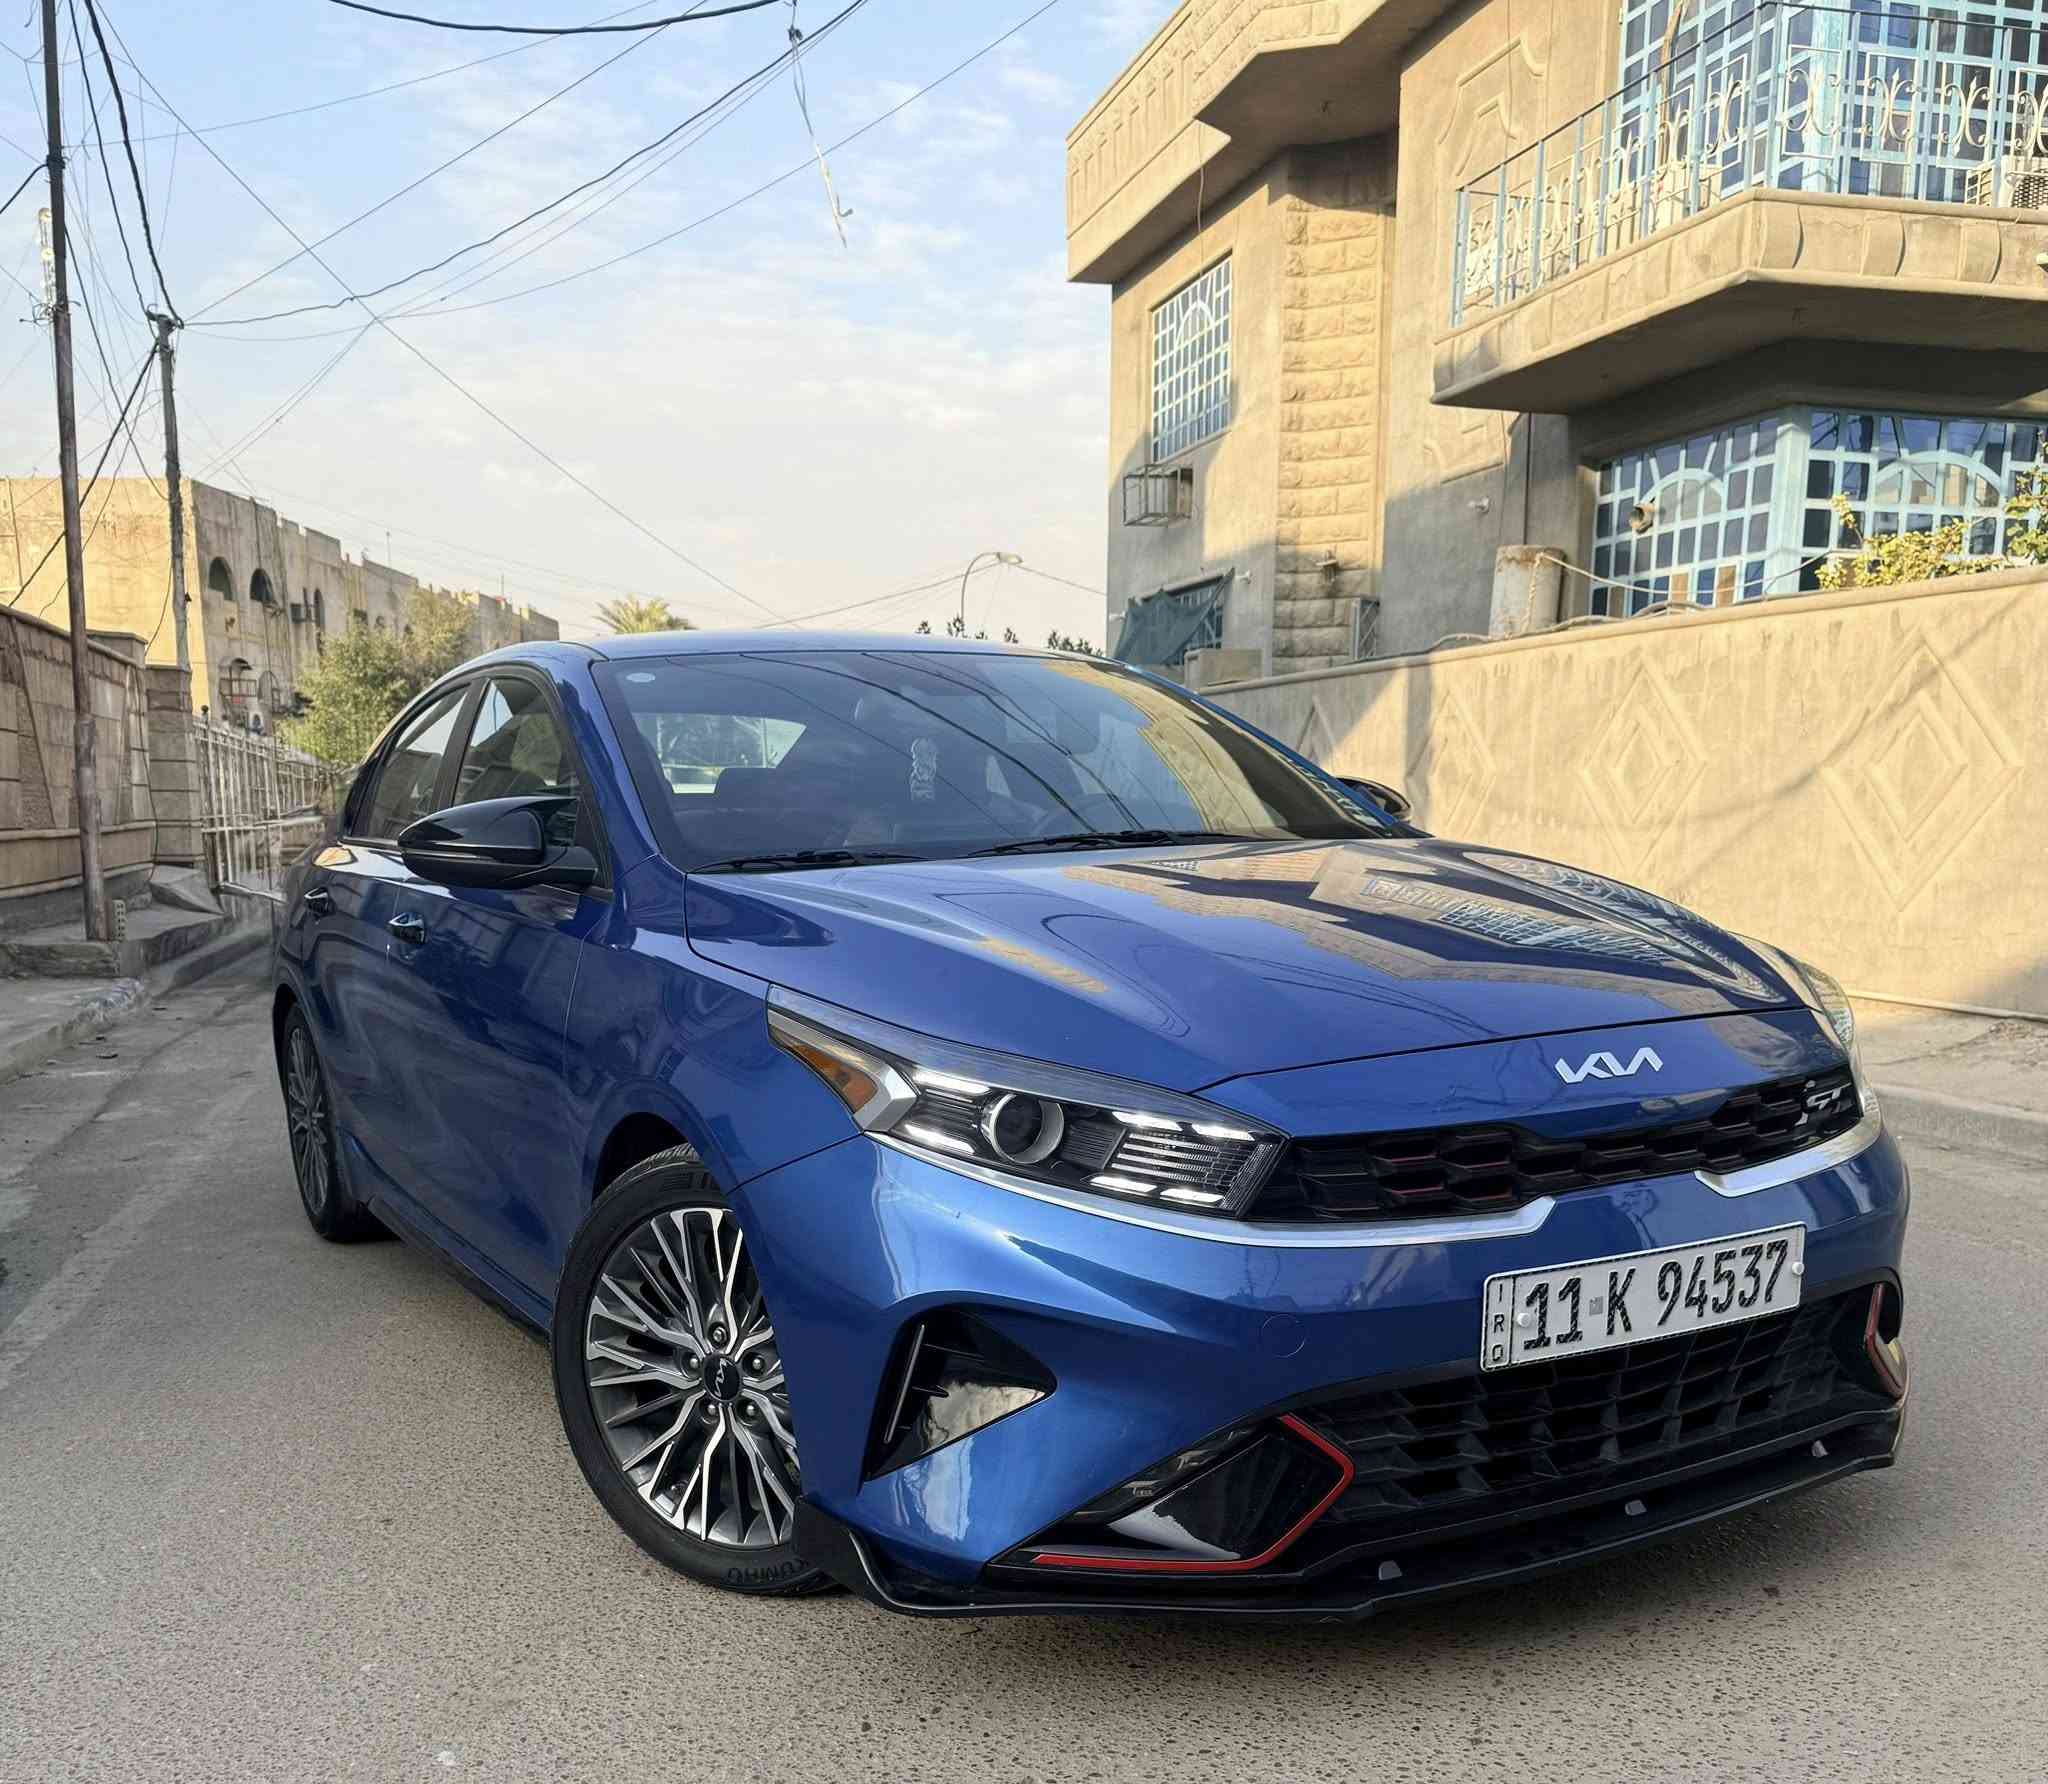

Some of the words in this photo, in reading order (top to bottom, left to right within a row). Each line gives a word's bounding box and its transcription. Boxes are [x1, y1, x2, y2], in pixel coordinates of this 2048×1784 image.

[1554, 1047, 1664, 1084] KIA
[1524, 1277, 1582, 1350] 11
[1606, 1268, 1637, 1335] K
[1657, 1240, 1788, 1326] 94537
